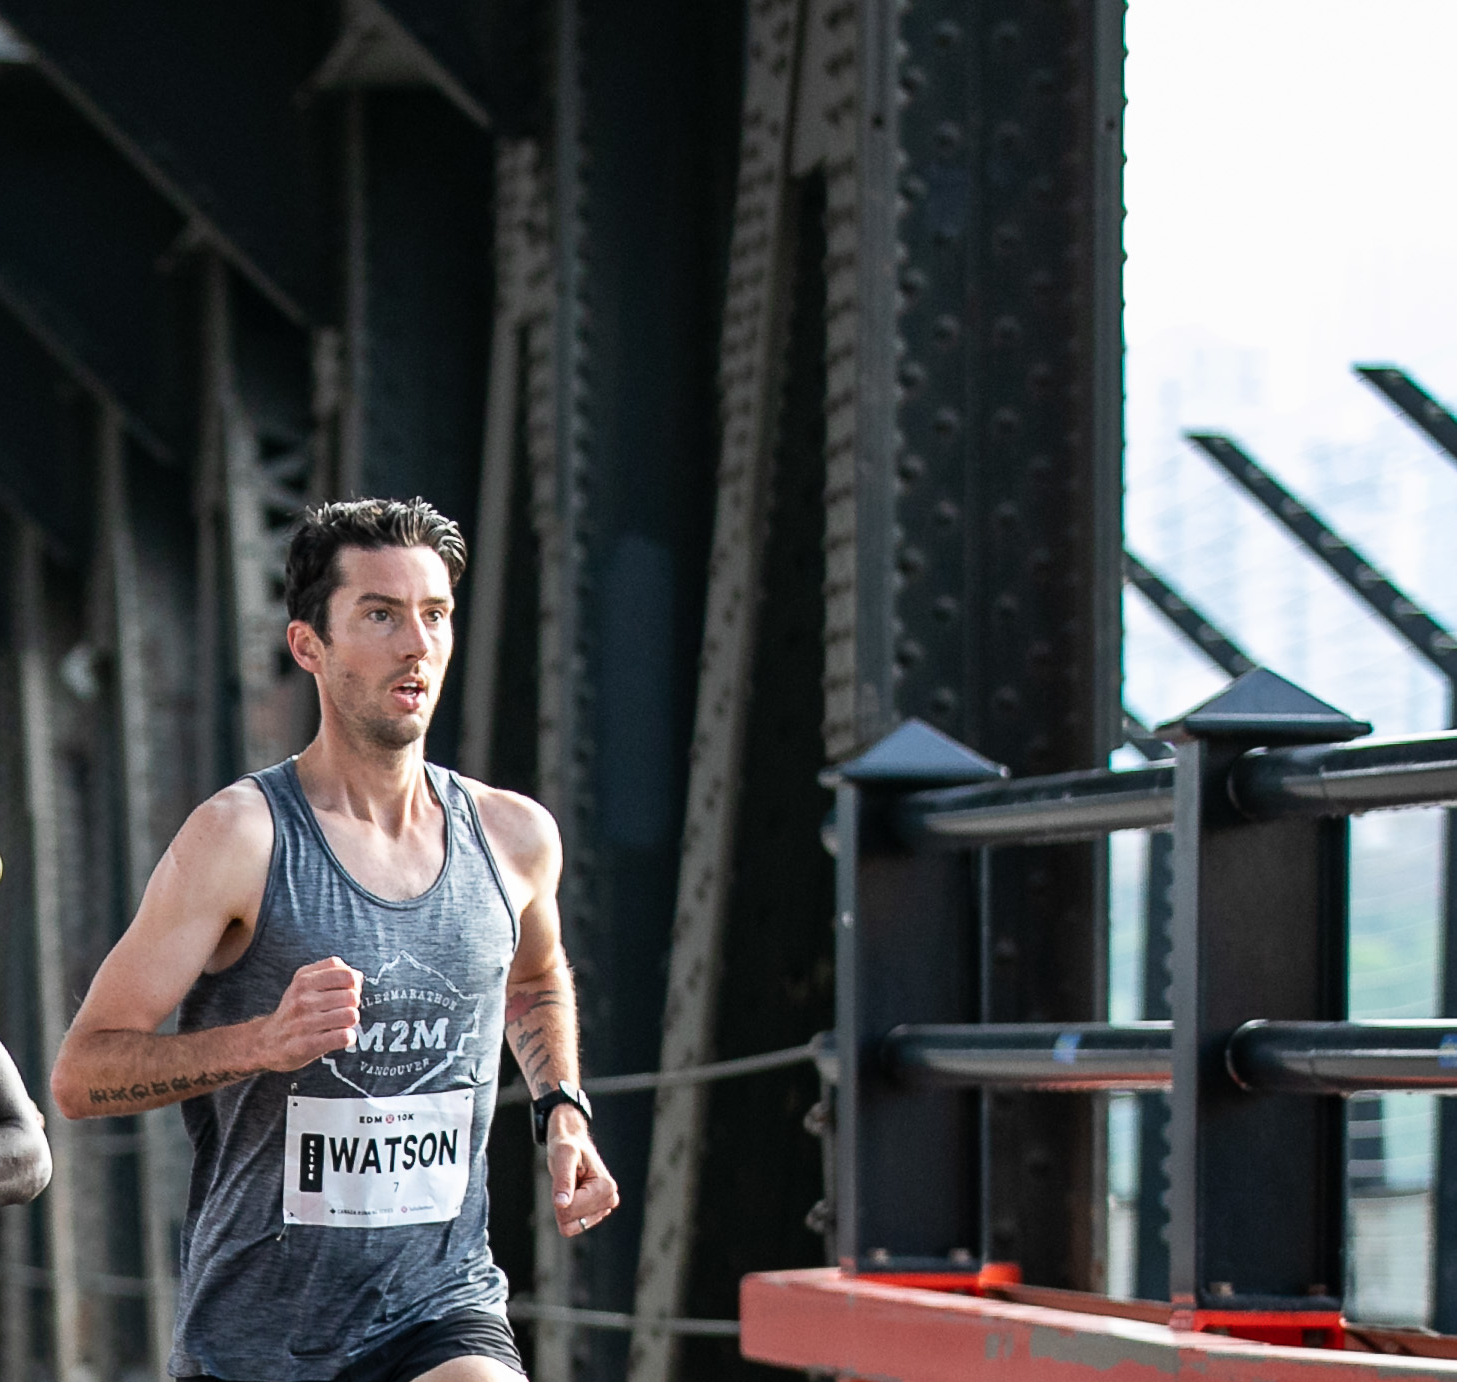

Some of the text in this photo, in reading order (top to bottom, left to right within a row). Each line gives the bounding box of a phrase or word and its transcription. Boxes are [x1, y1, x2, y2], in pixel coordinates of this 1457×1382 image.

[345, 1017, 449, 1054] M2M
[360, 1058, 430, 1076] VANCOUVER
[359, 1113, 415, 1124] EDM 10K
[329, 1128, 458, 1175] WATSON
[393, 1181, 400, 1193] 7
